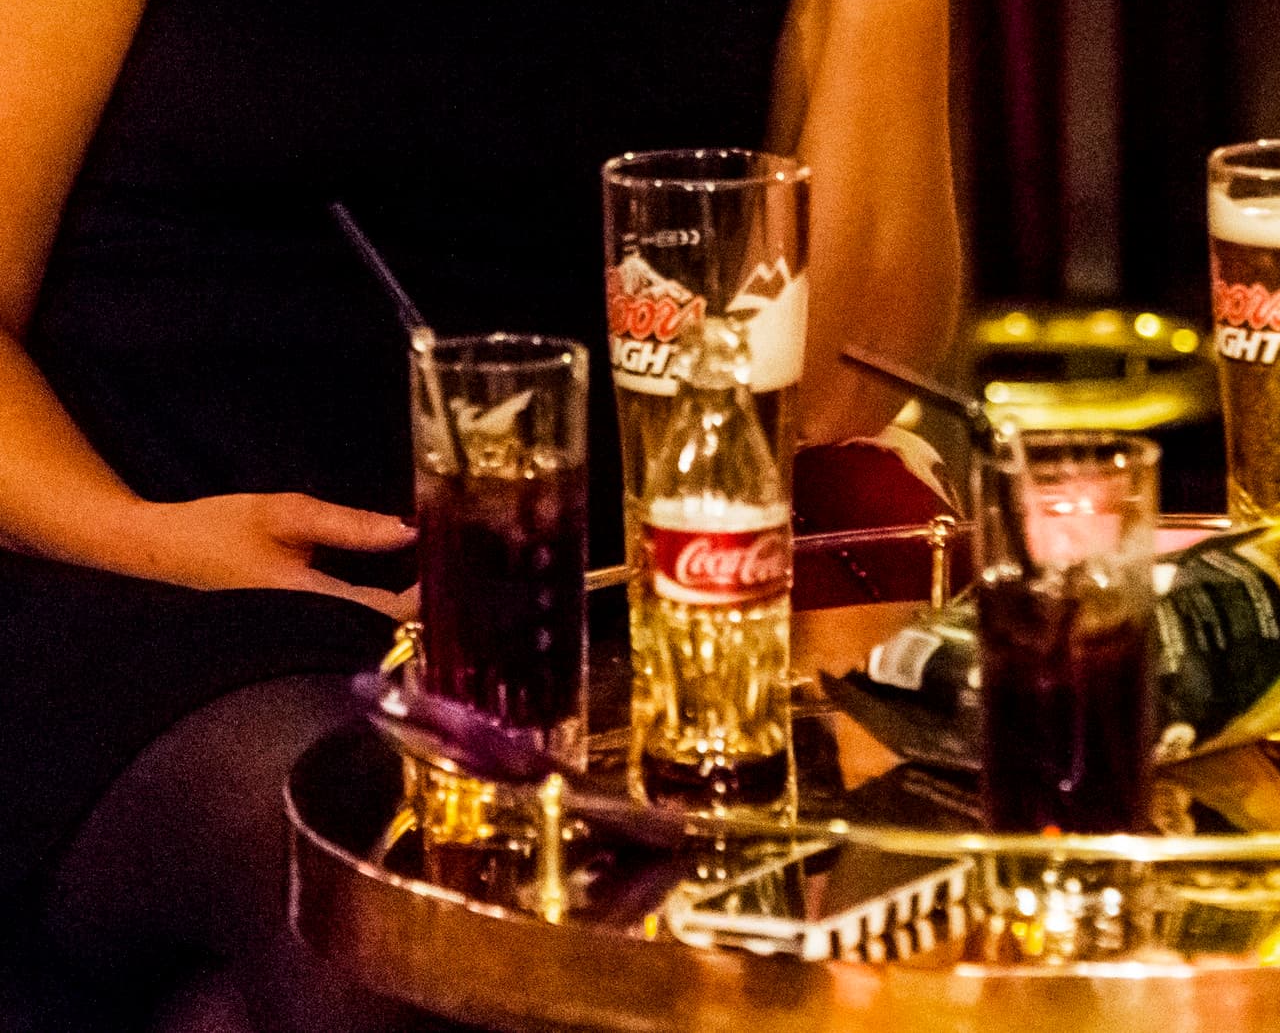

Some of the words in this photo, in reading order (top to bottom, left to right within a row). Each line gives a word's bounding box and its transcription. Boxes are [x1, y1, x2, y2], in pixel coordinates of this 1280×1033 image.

[605, 270, 707, 342] oors
[611, 337, 697, 381] IGH
[675, 534, 790, 585] Coca-Co
